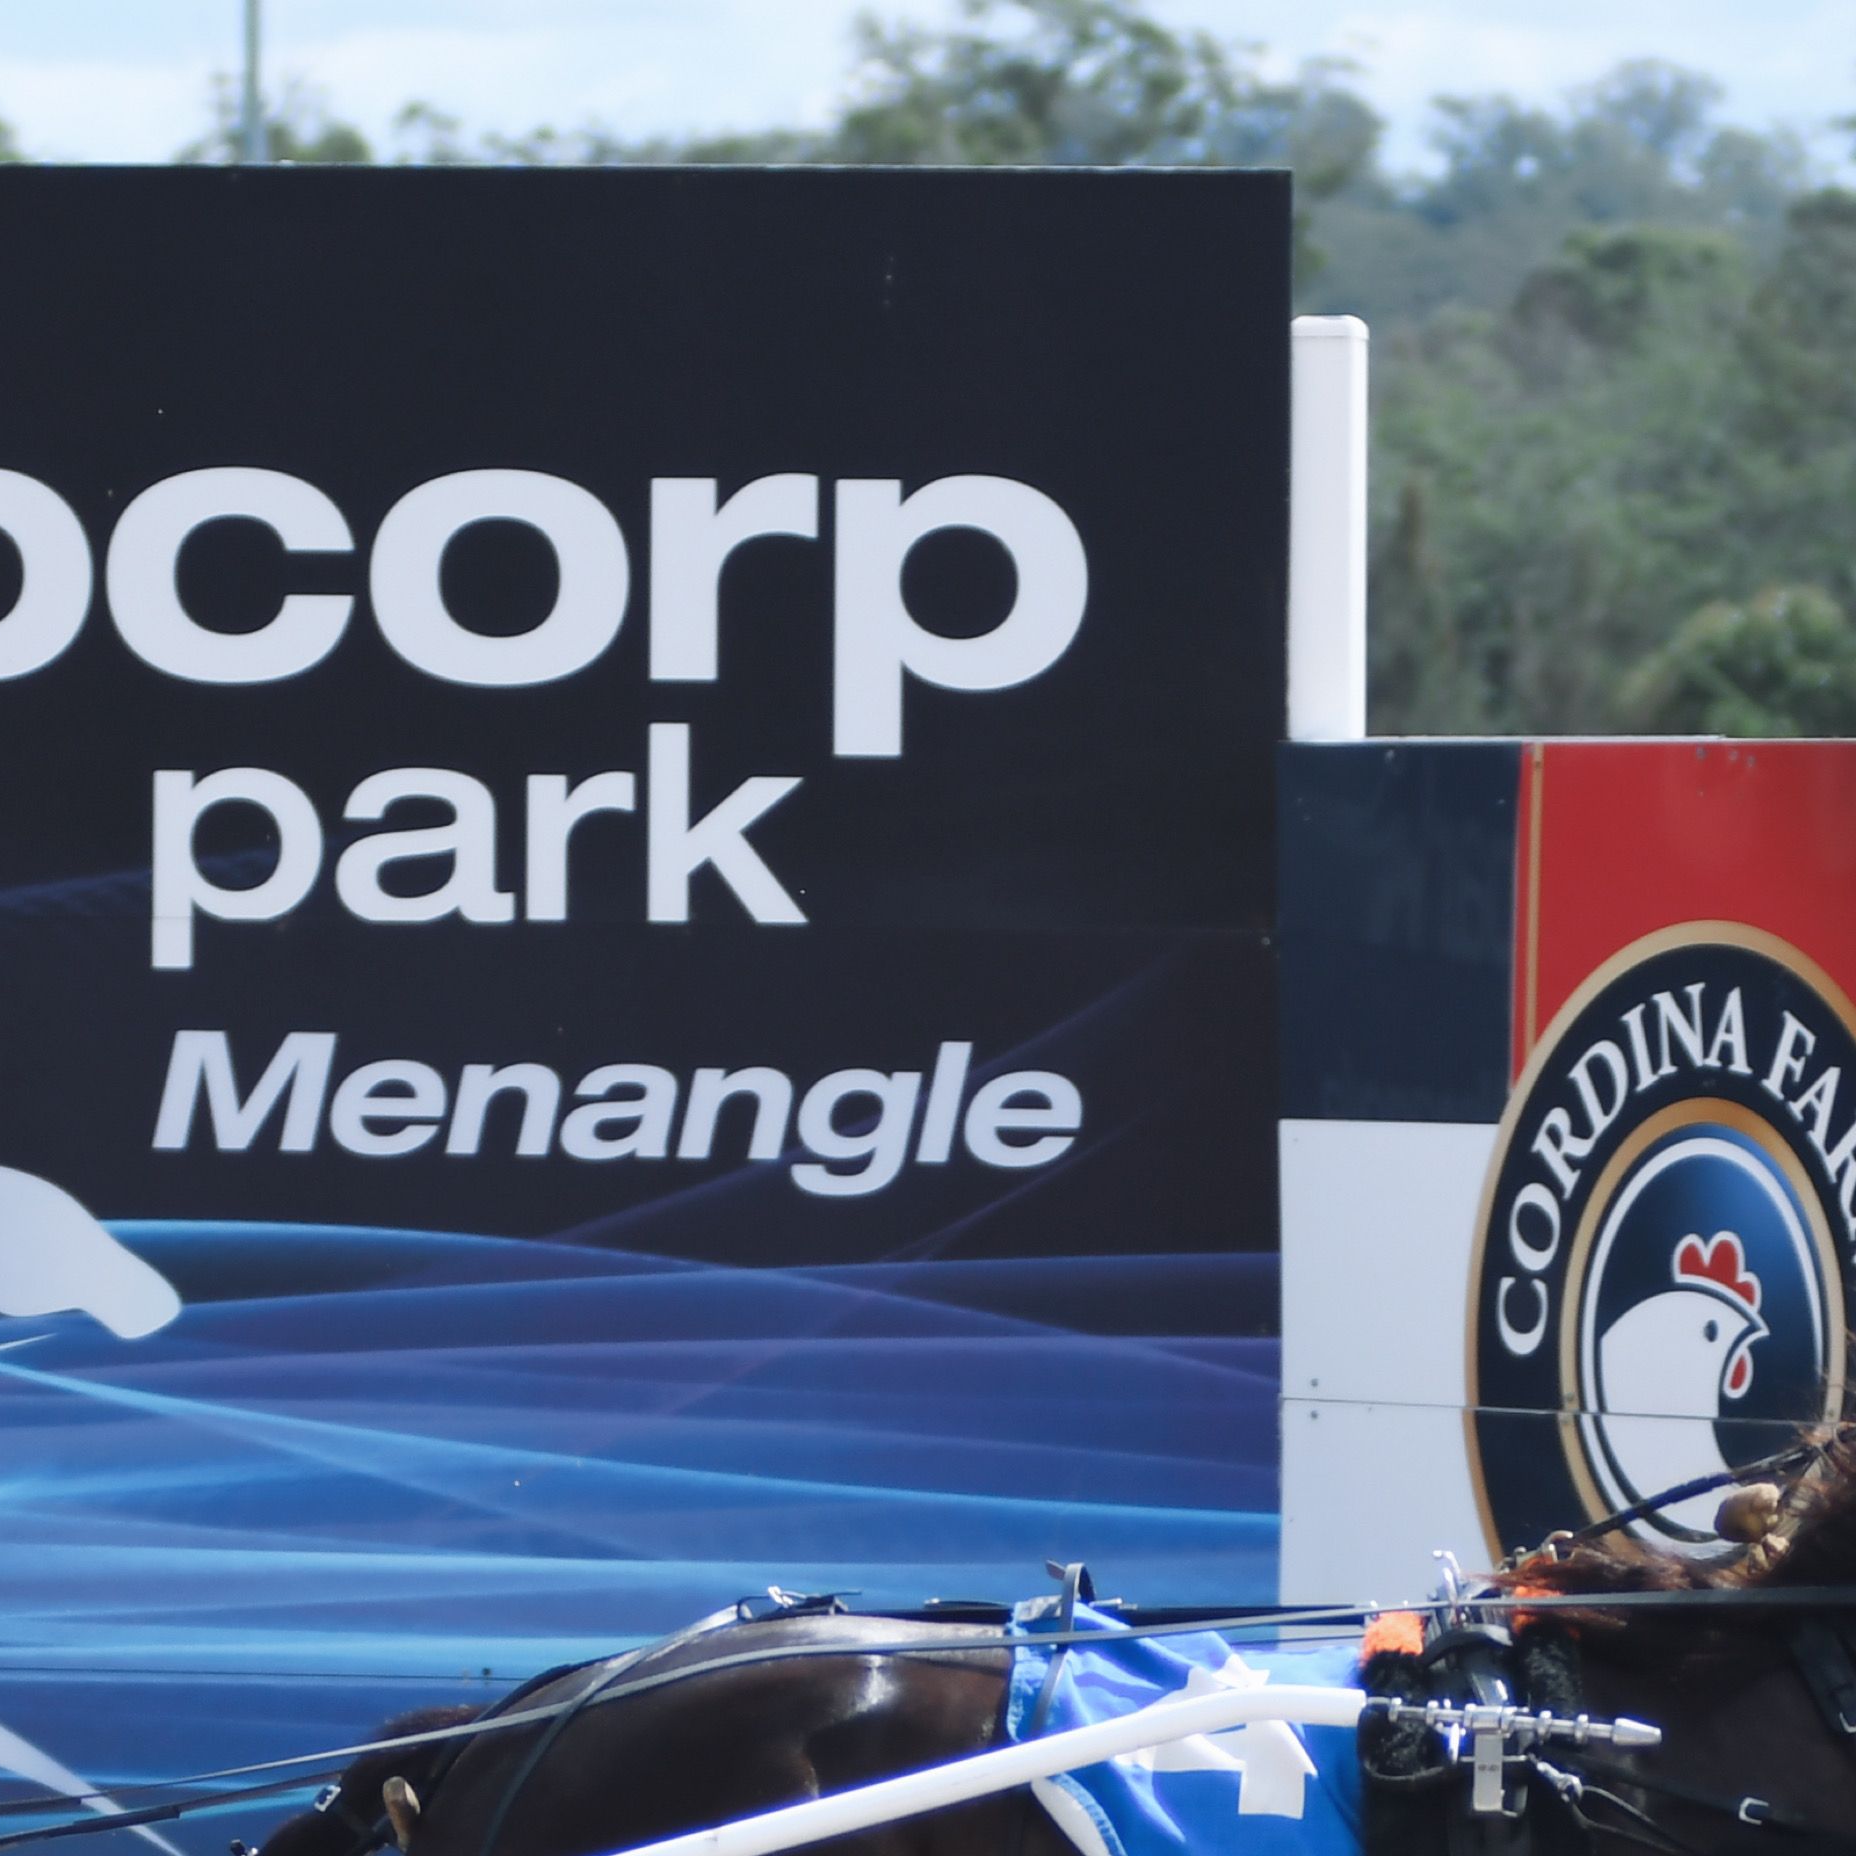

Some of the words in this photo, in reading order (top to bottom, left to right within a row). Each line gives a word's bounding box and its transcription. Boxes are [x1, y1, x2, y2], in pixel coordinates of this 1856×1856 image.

[152, 722, 807, 970] park
[153, 1030, 1082, 1196] Menangle
[1497, 982, 1753, 1356] CORDINA
